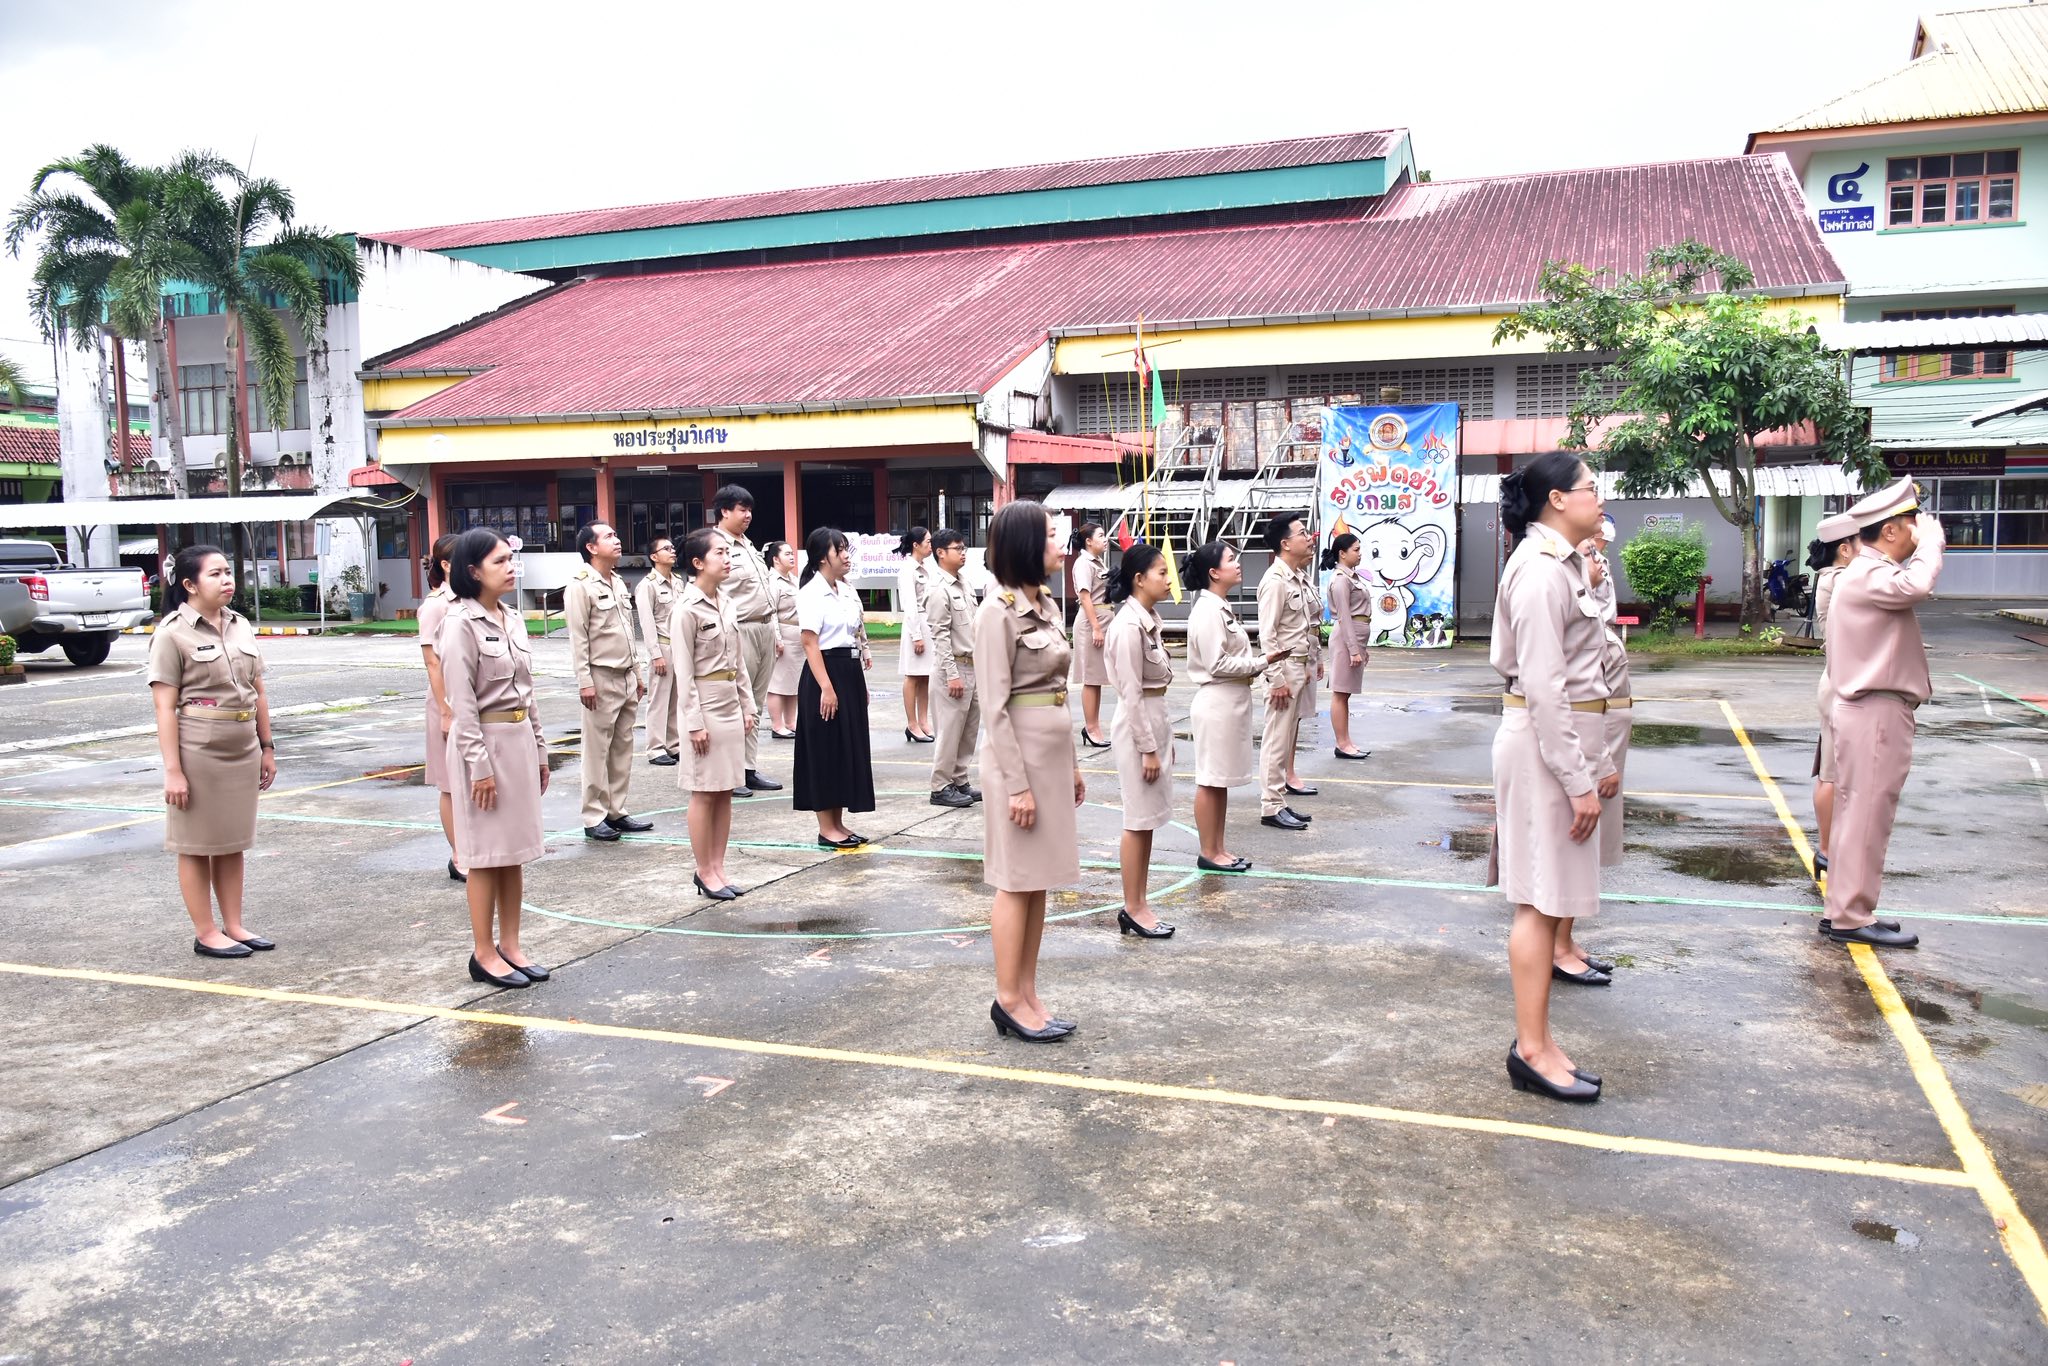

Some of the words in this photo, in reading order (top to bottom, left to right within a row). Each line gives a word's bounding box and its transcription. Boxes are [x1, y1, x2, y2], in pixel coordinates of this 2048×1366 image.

[1828, 162, 1870, 203] ๔
[1820, 215, 1873, 232] ไฟฟ้ากำลัง
[613, 424, 728, 452] หอประชุมวิเศษ
[1912, 454, 1941, 464] TPT
[1946, 452, 1988, 464] MART
[1356, 487, 1411, 510] เกมส์
